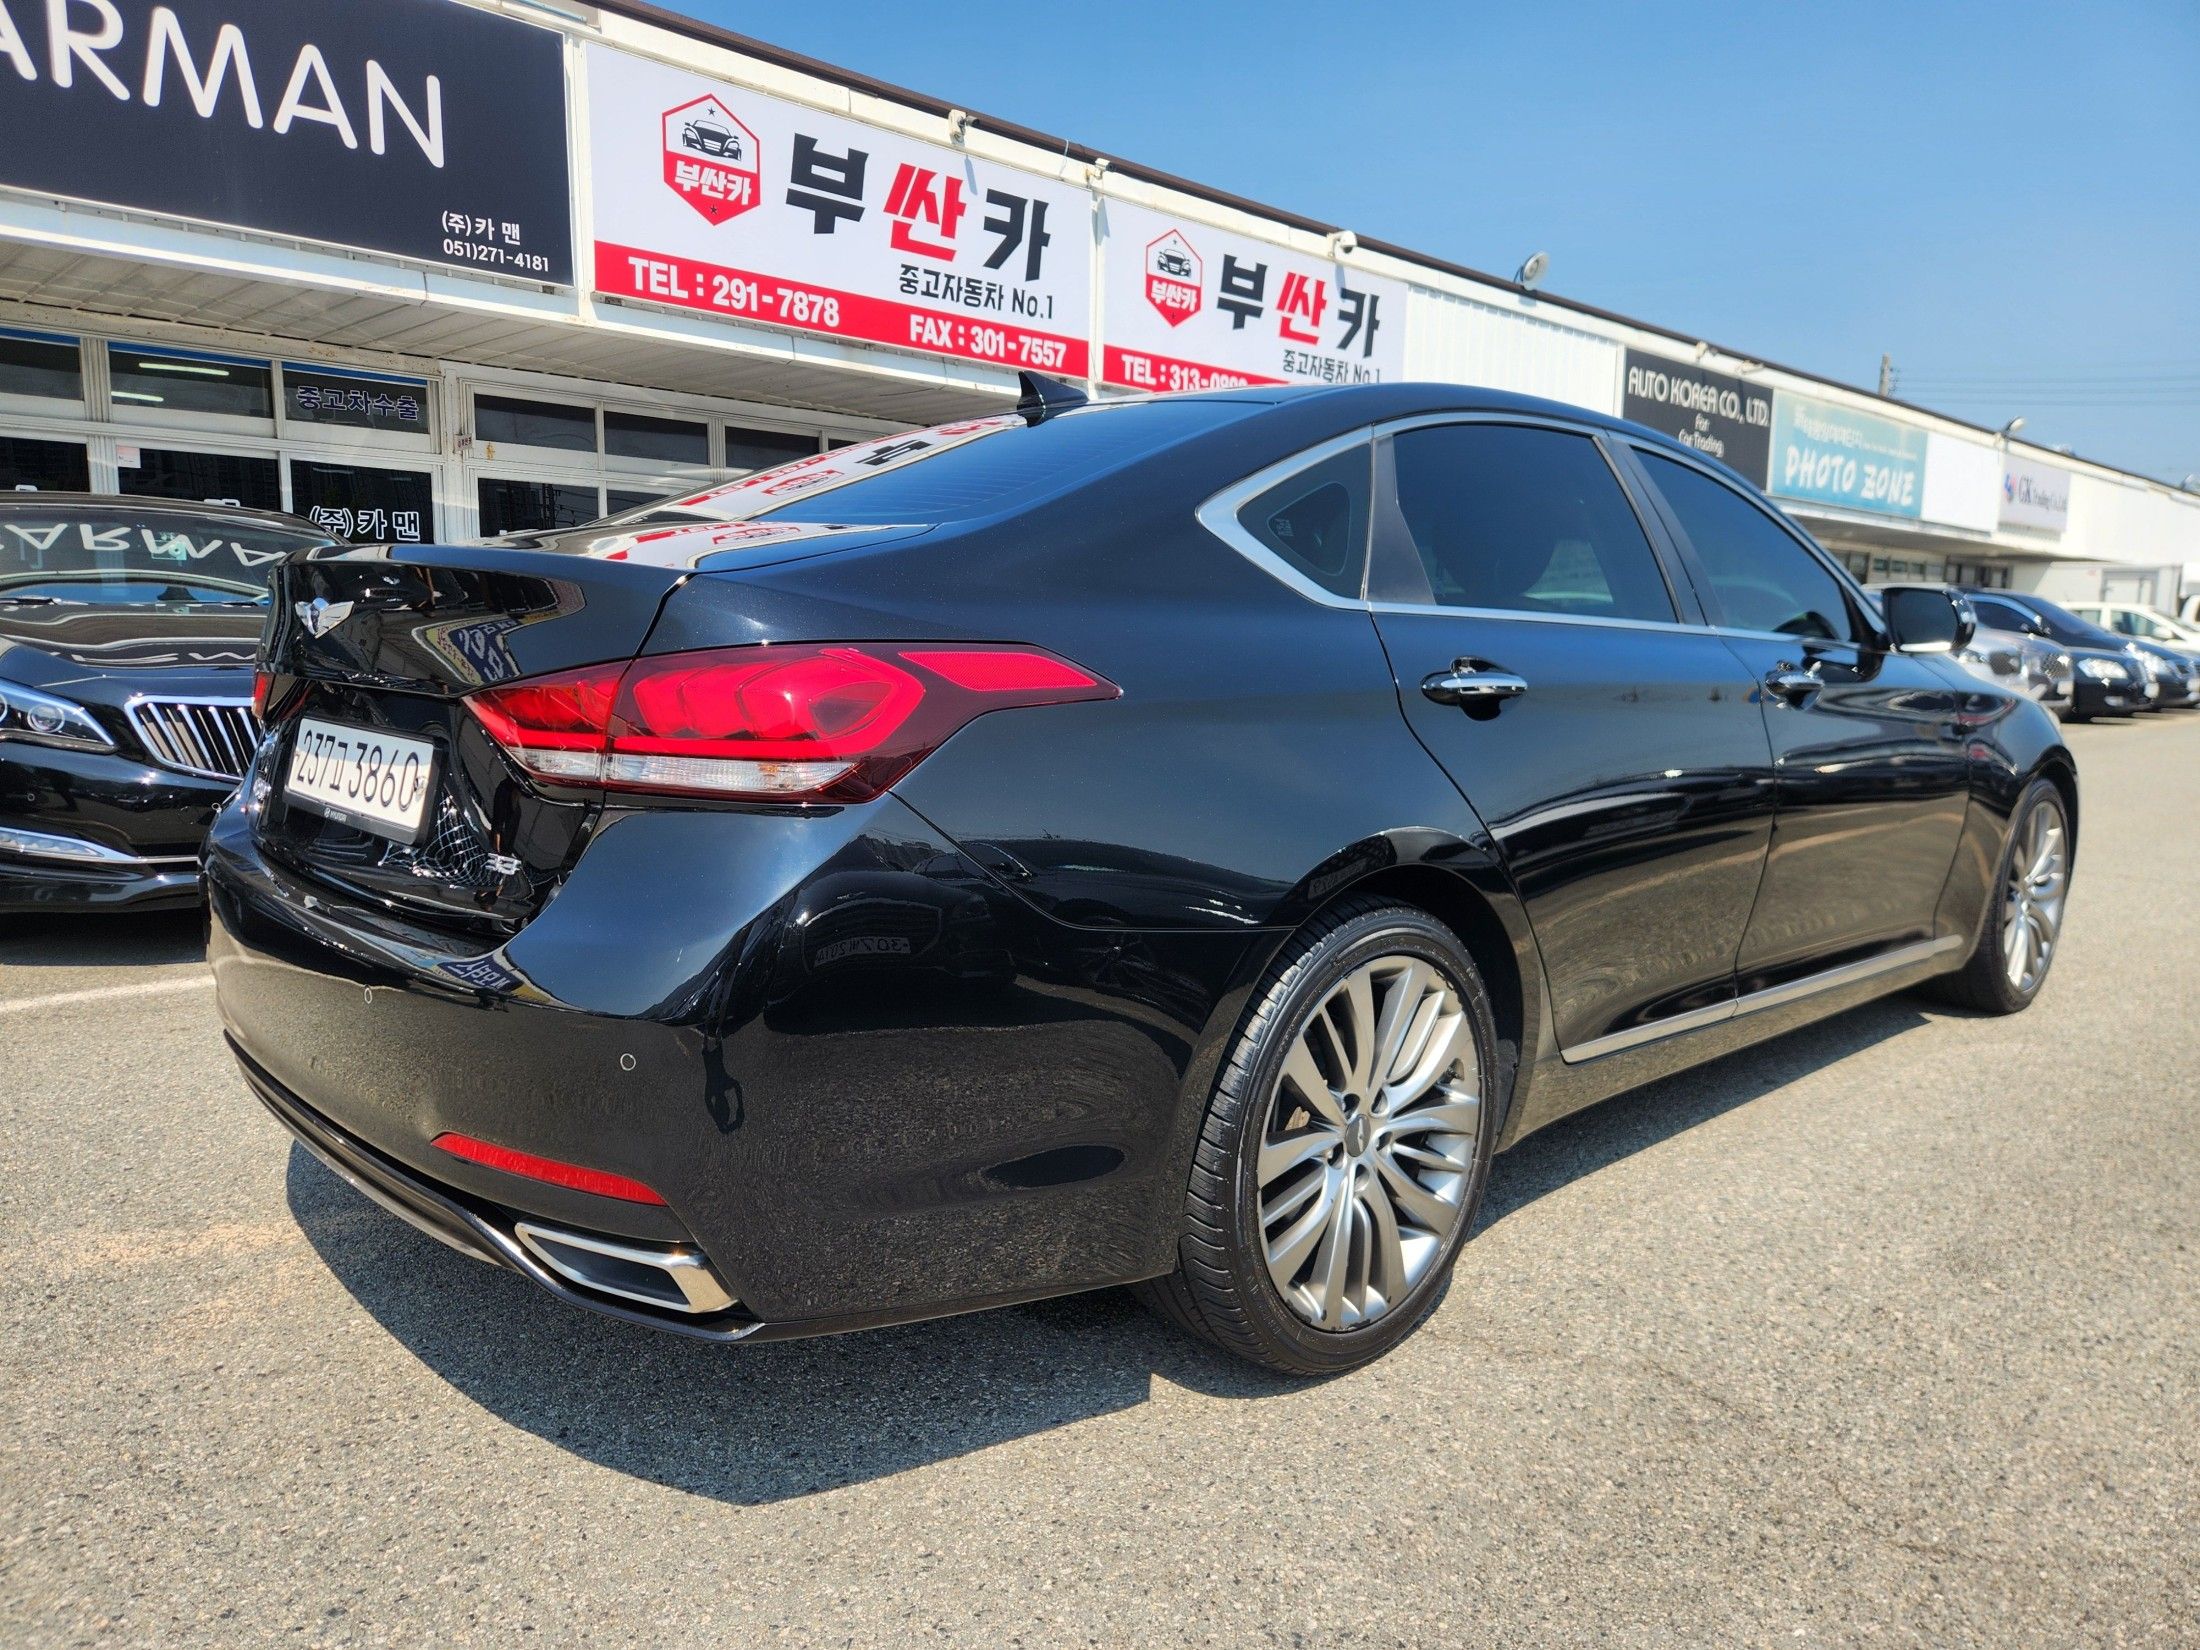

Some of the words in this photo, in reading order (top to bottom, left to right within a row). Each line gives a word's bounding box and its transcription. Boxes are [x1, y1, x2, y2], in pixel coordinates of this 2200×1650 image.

[674, 160, 752, 206] 부싼카
[443, 238, 549, 272] 051)271-4181
[712, 275, 840, 328] 291-7878
[899, 263, 1004, 311] 중고자동차
[1012, 287, 1053, 319] No.1
[970, 325, 1067, 368] 301-7557
[296, 385, 420, 421] 중고차수출
[1628, 366, 1670, 402] AUTO
[1670, 376, 1719, 414] KOREA
[1746, 396, 1770, 427] LTD.
[1785, 445, 1857, 493] PHOTO
[1860, 463, 1915, 506] ZONE
